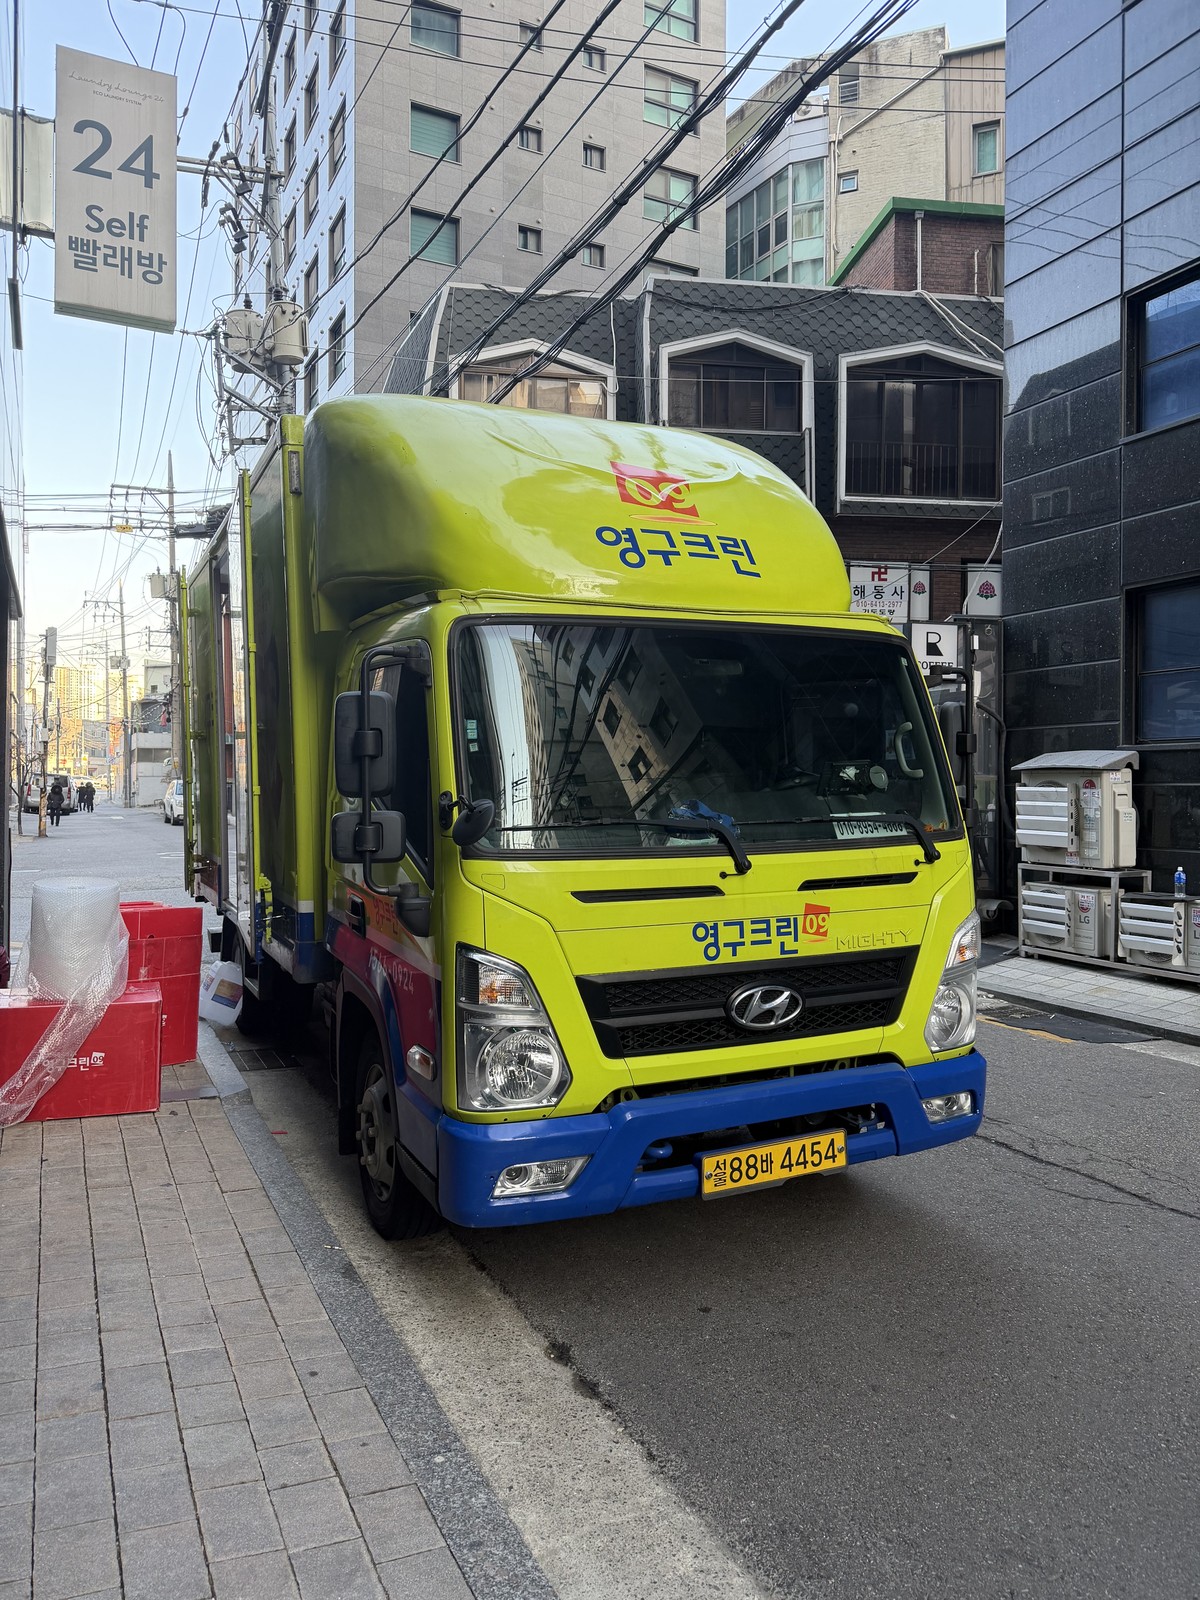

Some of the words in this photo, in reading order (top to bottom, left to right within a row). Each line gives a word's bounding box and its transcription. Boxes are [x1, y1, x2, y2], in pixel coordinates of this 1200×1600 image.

[69, 71, 113, 91] Laundry
[115, 83, 152, 101] Lounge
[104, 93, 125, 102] LAUNDRY
[125, 98, 142, 106] SYSTEM
[72, 119, 160, 190] 24
[85, 204, 149, 243] Self
[68, 235, 167, 285] 빨래방
[595, 526, 761, 578] 영구크린
[926, 631, 943, 656] R
[692, 916, 799, 962] 영구크린
[805, 913, 829, 935] 09
[1079, 915, 1090, 925] LG
[836, 928, 912, 951] MIGHTY
[780, 1137, 837, 1173] 4454
